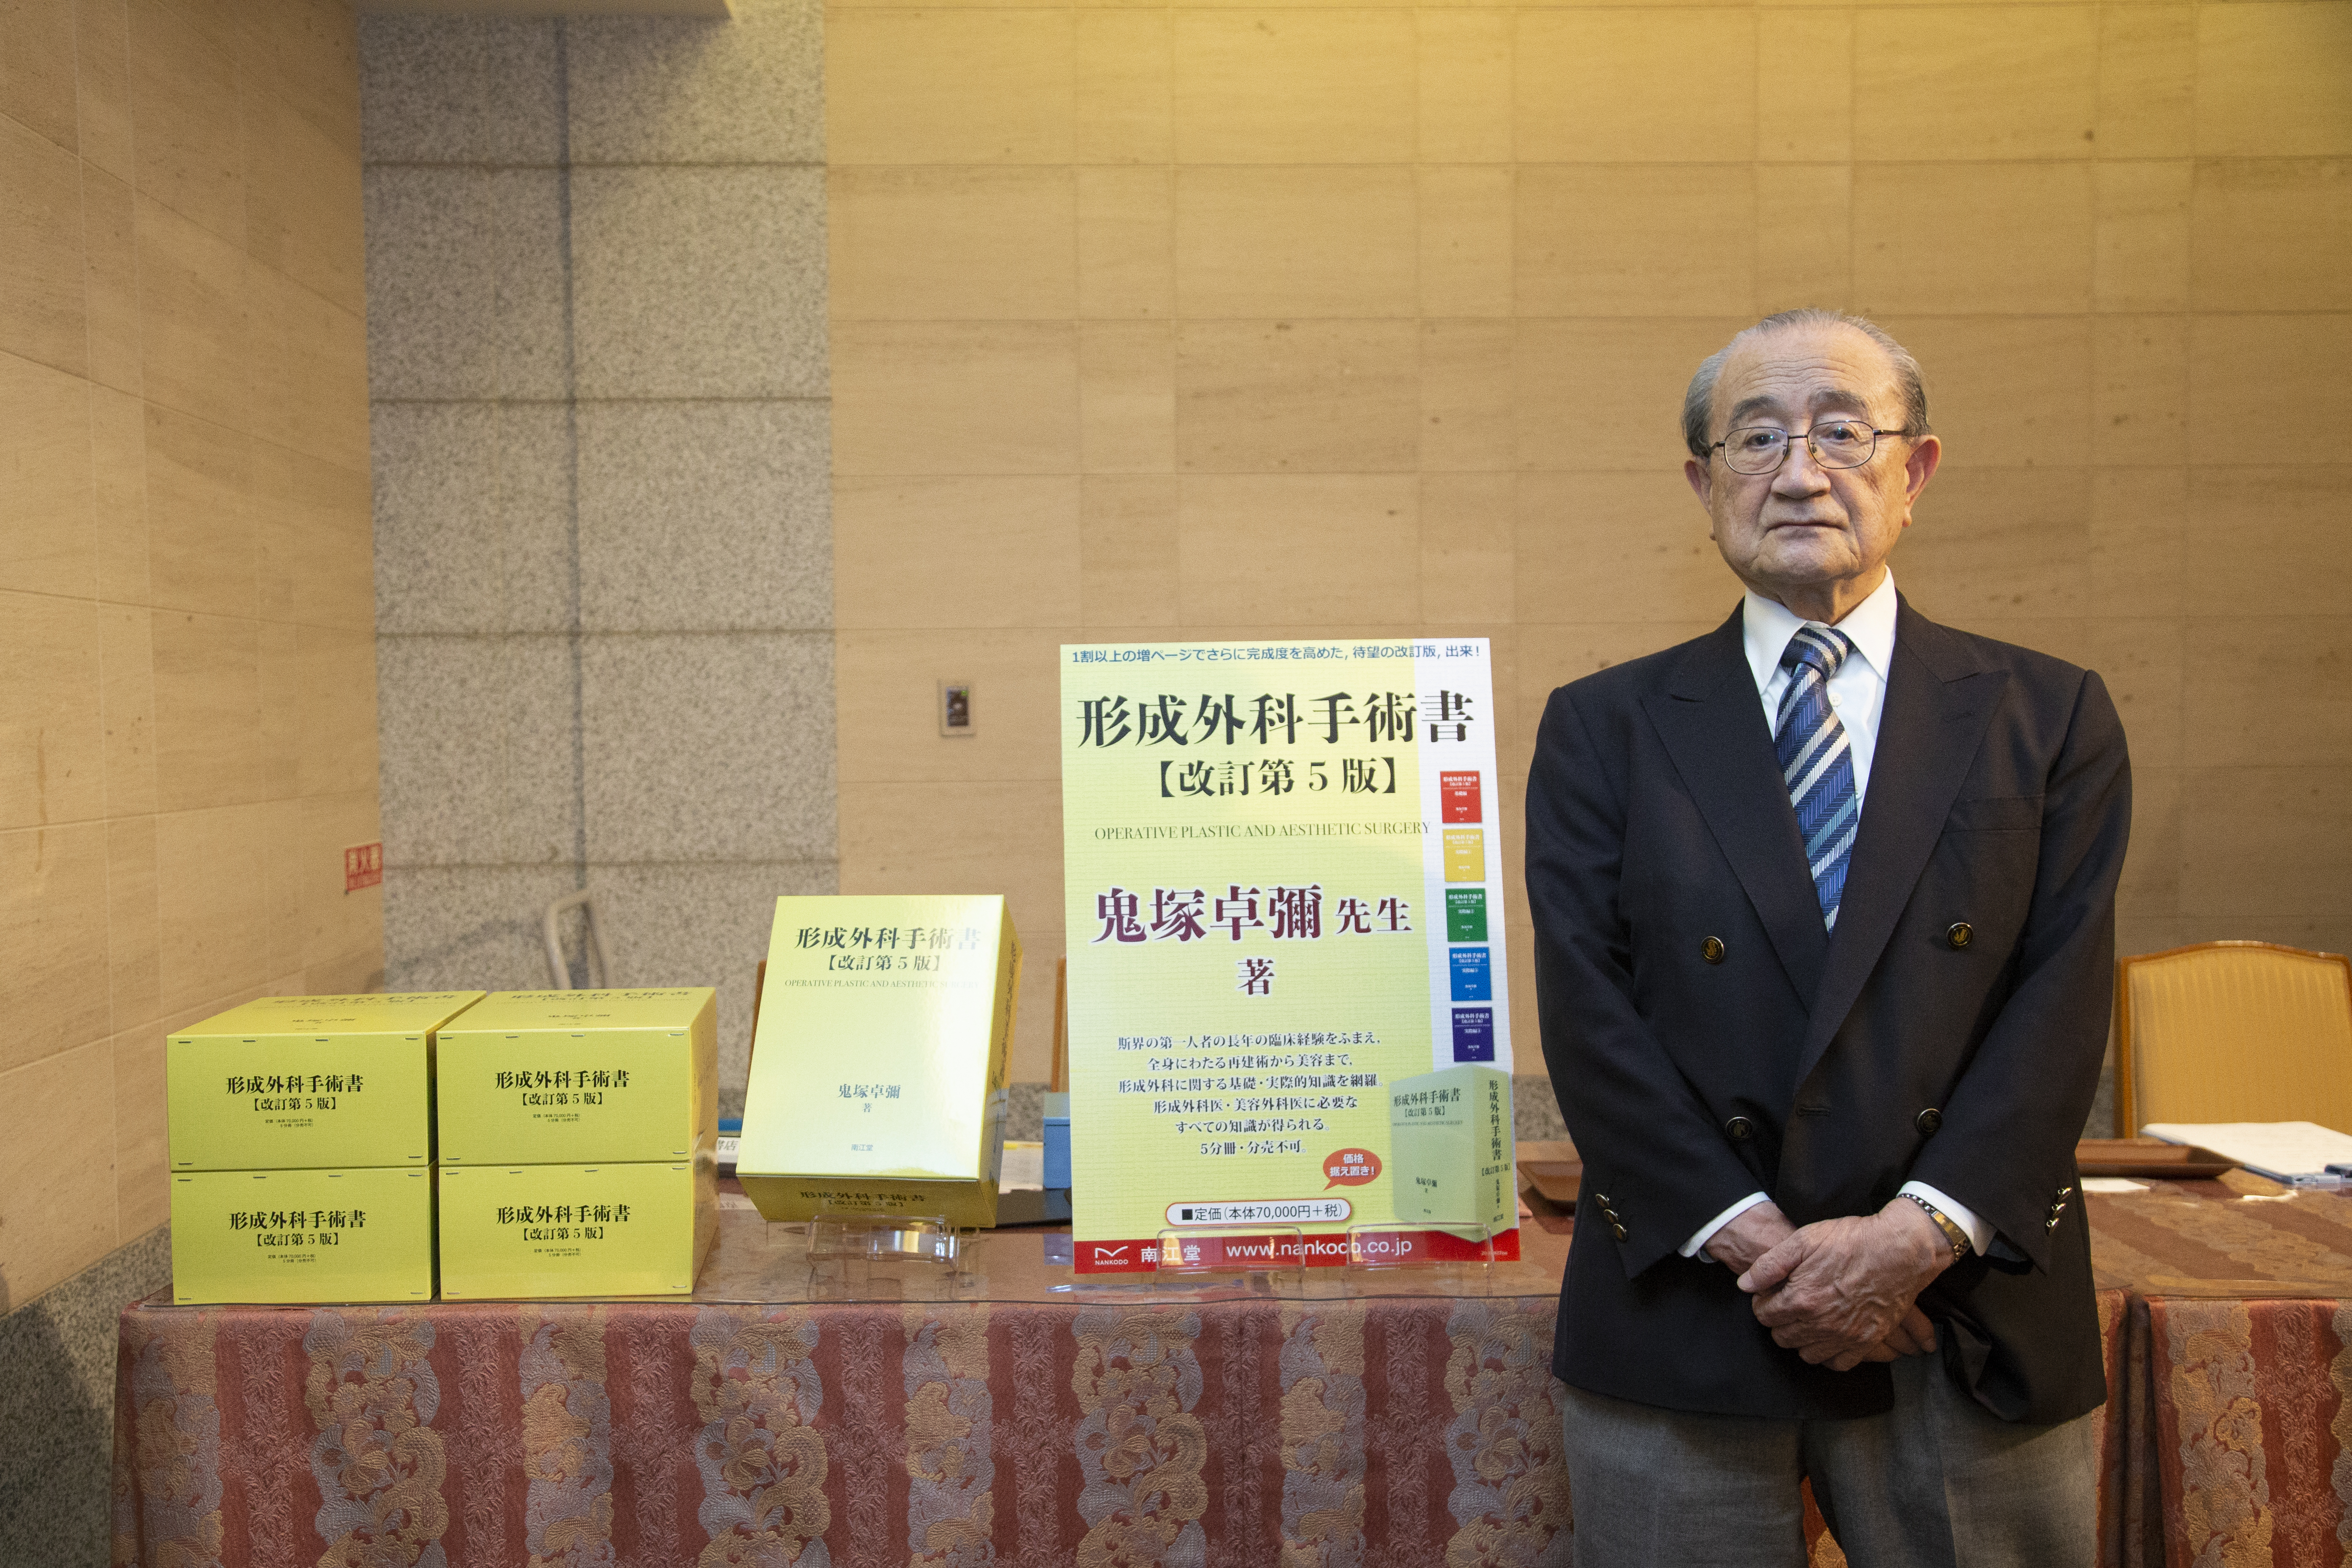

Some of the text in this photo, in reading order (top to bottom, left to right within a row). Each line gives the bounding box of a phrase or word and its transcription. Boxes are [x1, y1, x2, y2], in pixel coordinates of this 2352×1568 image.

[1076, 689, 1474, 748] 形成外科手術書
[1095, 821, 1431, 840] OPERATIVE PLASTIC AND AESTHETIC SURGERY
[1335, 897, 1413, 934] 先生
[794, 926, 982, 950] 形成外科手術書
[1237, 958, 1275, 995] 著
[226, 1074, 364, 1095] 形成外科手術書
[495, 1069, 630, 1089] 形成外科手術書
[1119, 1074, 1383, 1093] 形成外科に関する基礎・実際的知識を網羅。
[1154, 1095, 1358, 1114] 形成外科医・美容外科医に必要な
[1394, 1087, 1461, 1107] 形成外科手術書
[862, 1103, 872, 1112] 著
[1176, 1118, 1330, 1134] すべての知識が得られる。
[1489, 1080, 1502, 1161] 形成外科手術書
[1200, 1139, 1306, 1155] 5分冊・分売不可。
[1343, 1153, 1364, 1164] 価格
[1329, 1166, 1376, 1177] 据え置き！
[229, 1209, 366, 1230] 形成外科手術書
[496, 1203, 631, 1224] 形成外科手術書
[1141, 1244, 1201, 1263] 南江堂
[1226, 1237, 1413, 1257] www.nankodo.co.jp
